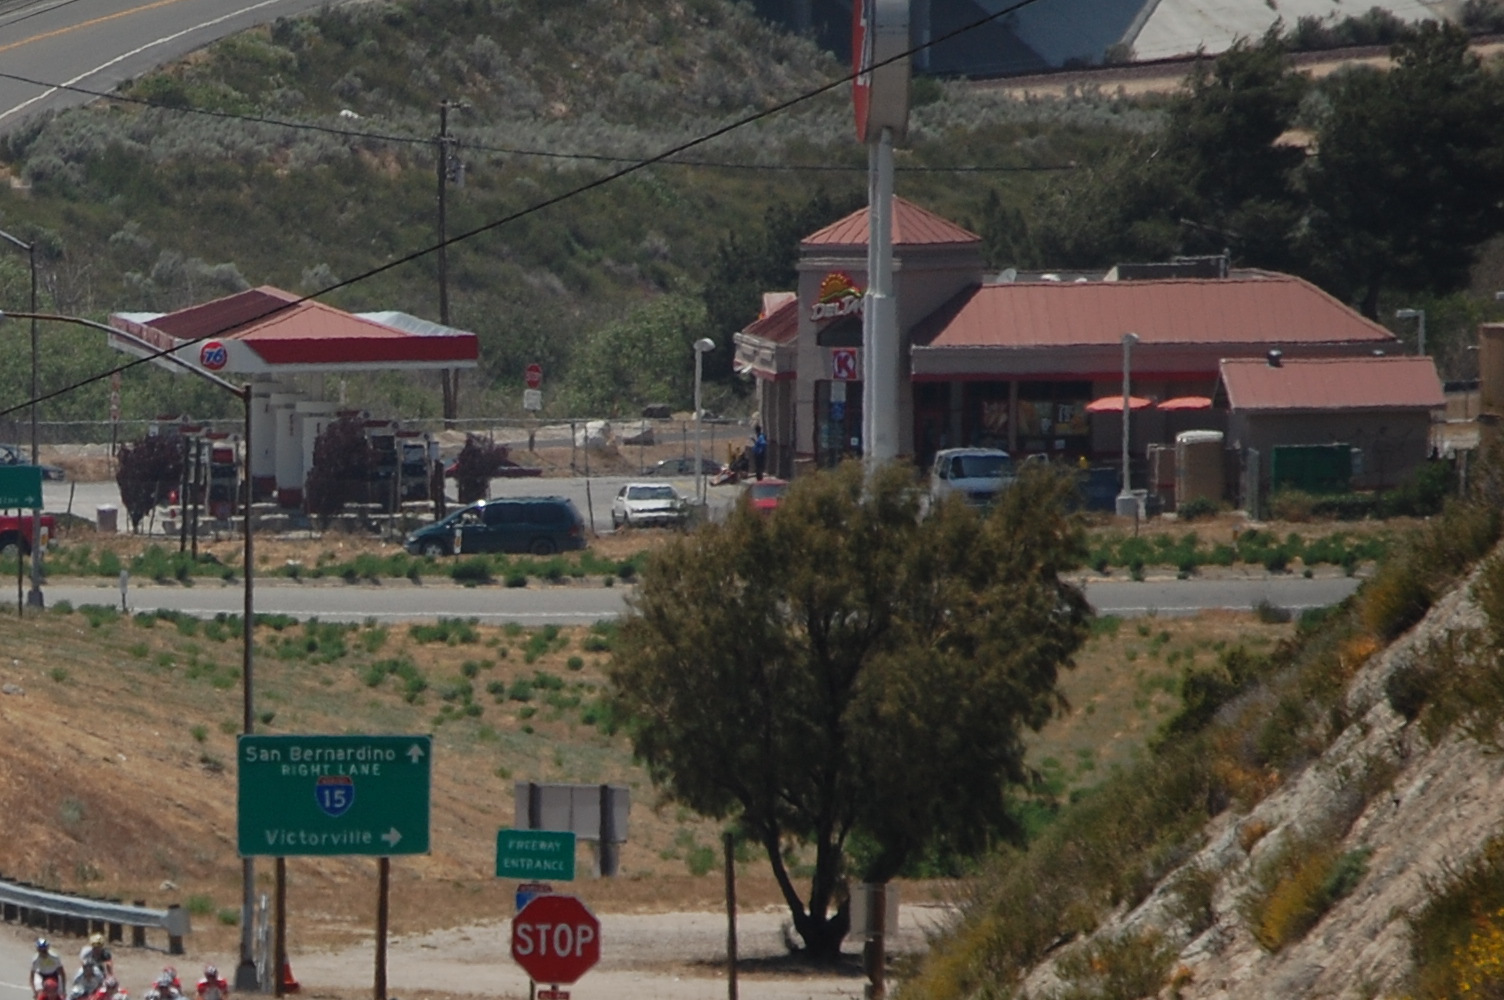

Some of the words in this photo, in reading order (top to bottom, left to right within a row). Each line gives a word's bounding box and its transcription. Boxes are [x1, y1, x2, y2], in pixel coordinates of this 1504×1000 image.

[202, 346, 225, 365] 76
[245, 746, 281, 762] San
[290, 745, 396, 762] Bernardino
[281, 764, 331, 776] RIGHT
[339, 763, 381, 776] LANE
[324, 789, 346, 808] 15
[264, 829, 373, 846] Victorville
[508, 840, 562, 852] FREEWAY
[503, 858, 566, 871] ENTRANCE
[516, 923, 594, 958] STOP
